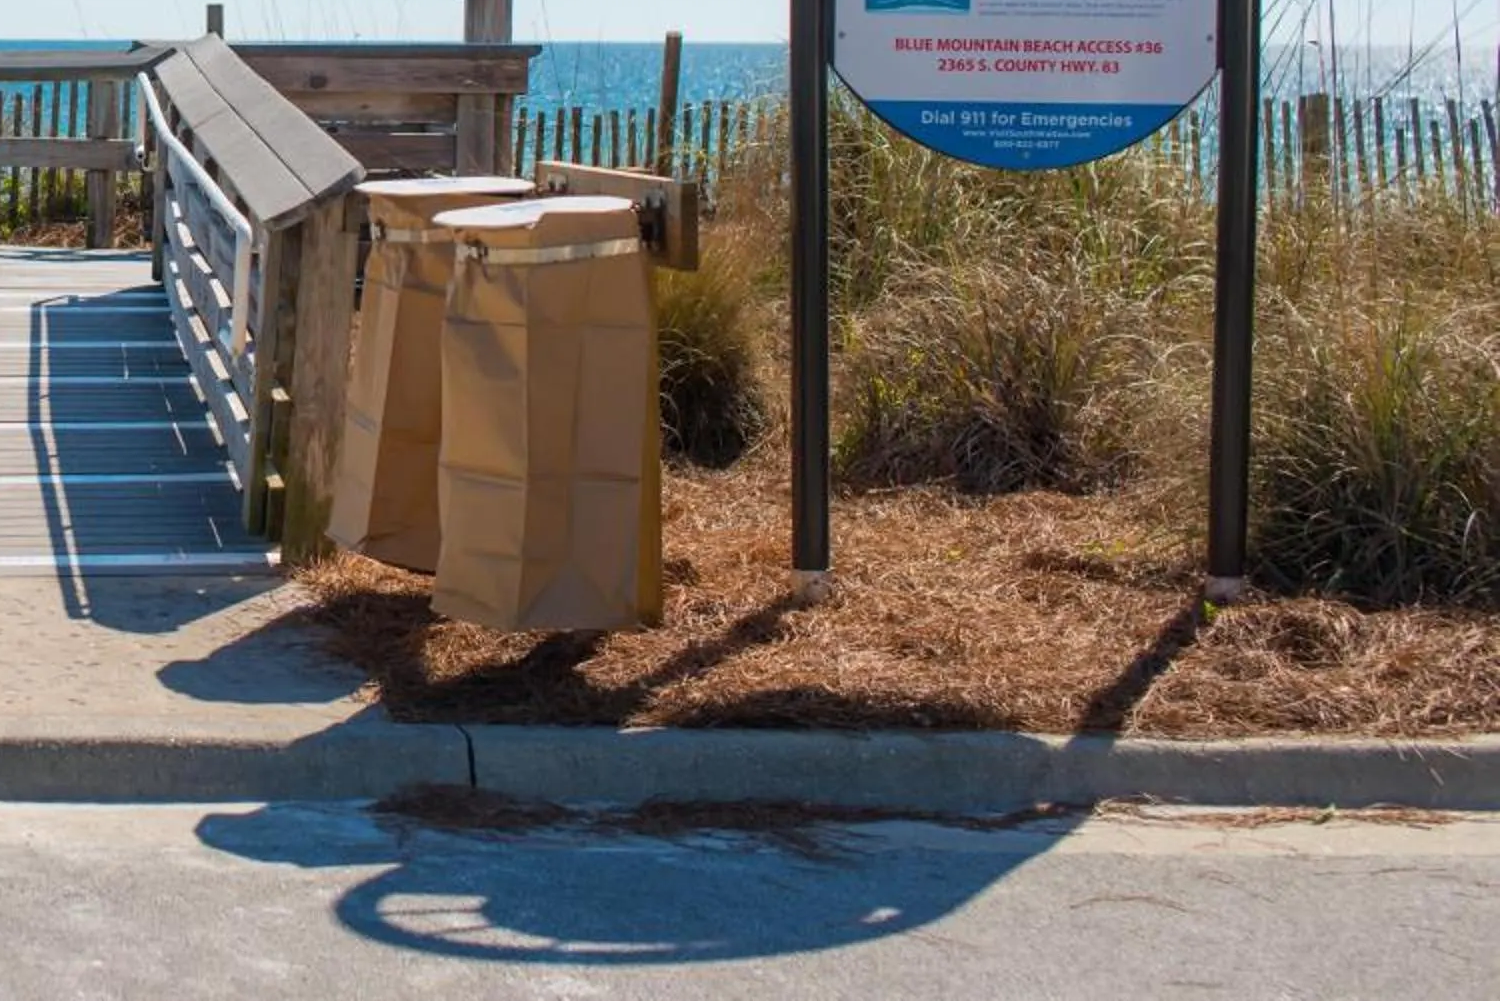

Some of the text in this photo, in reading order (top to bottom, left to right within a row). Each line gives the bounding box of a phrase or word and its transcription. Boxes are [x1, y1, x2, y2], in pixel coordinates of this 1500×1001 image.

[895, 38, 1162, 54] BLUE MOUNTAIN BEACH ACCESS #36
[937, 58, 975, 72] 2365
[978, 59, 991, 72] S.
[995, 59, 1056, 73] COUNTY
[1061, 60, 1099, 74] HWY.
[921, 110, 1133, 128] Dial 911 for Emergencies
